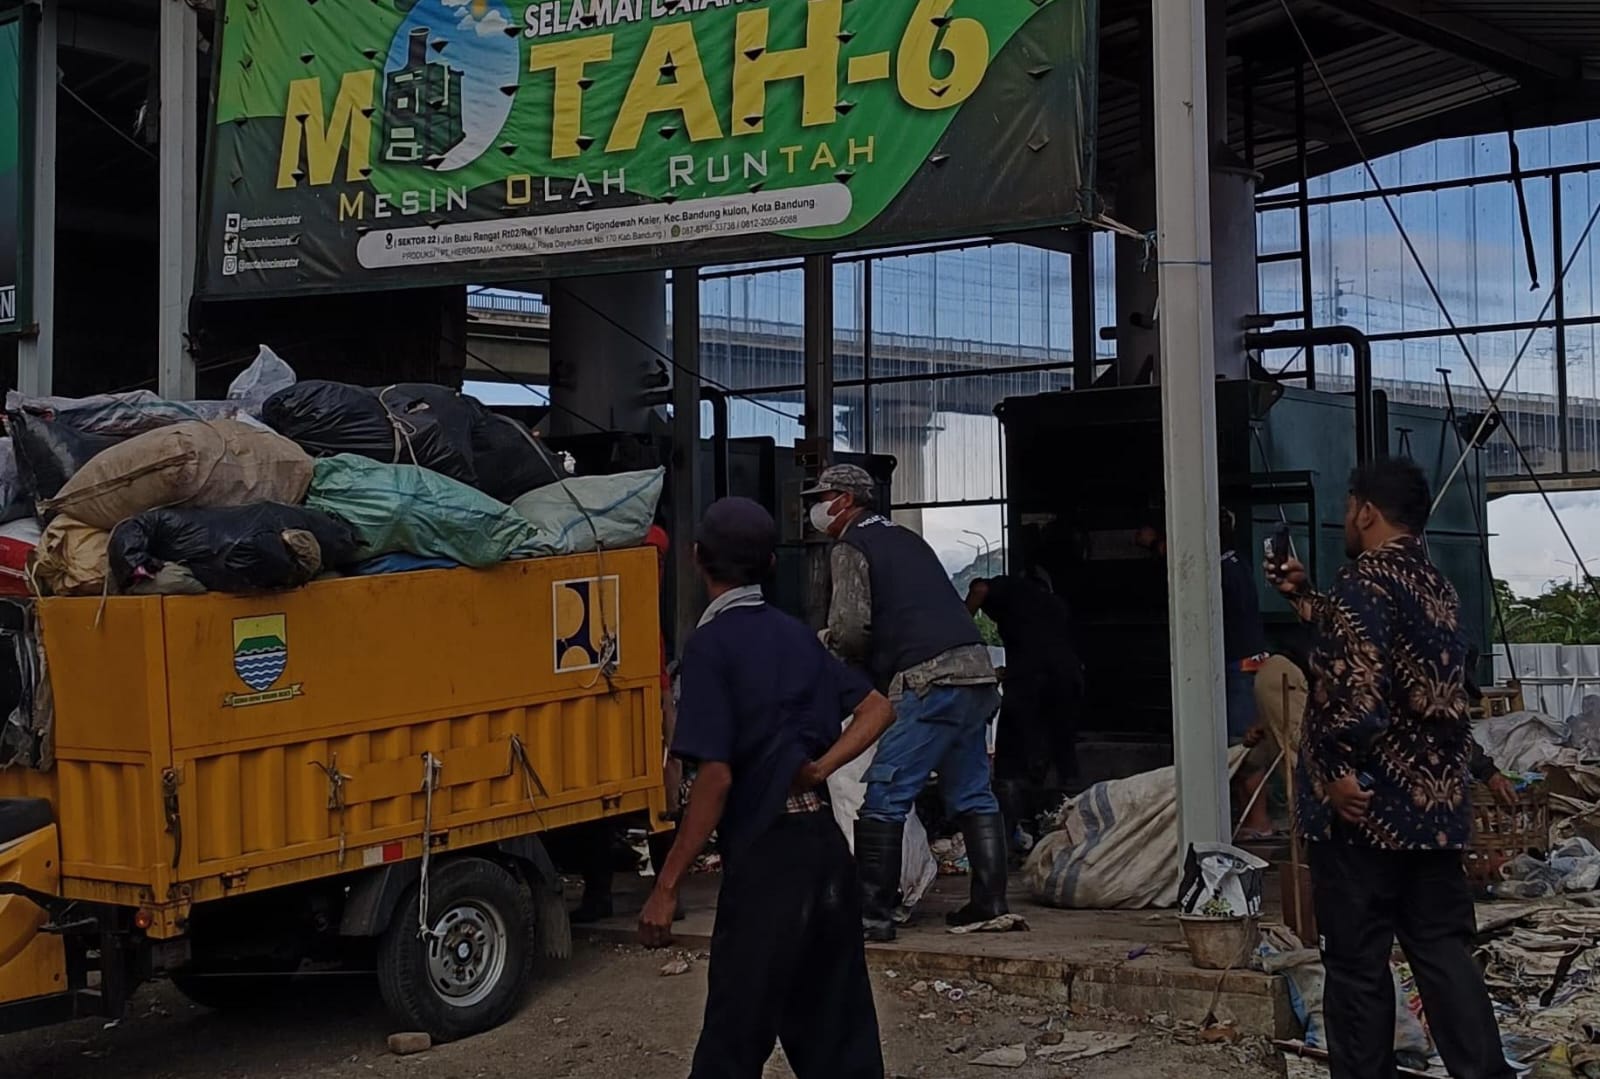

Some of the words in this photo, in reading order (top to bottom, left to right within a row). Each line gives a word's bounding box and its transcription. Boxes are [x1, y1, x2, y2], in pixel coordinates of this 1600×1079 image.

[338, 185, 469, 222] MESIN
[506, 168, 627, 205] OLAH
[668, 135, 875, 188] RUNTAH
[454, 233, 472, 243] Batu
[544, 223, 585, 235] Kelurahan
[586, 217, 636, 233] Cigondewah
[751, 202, 772, 213] Kota
[774, 199, 815, 211] Bandung
